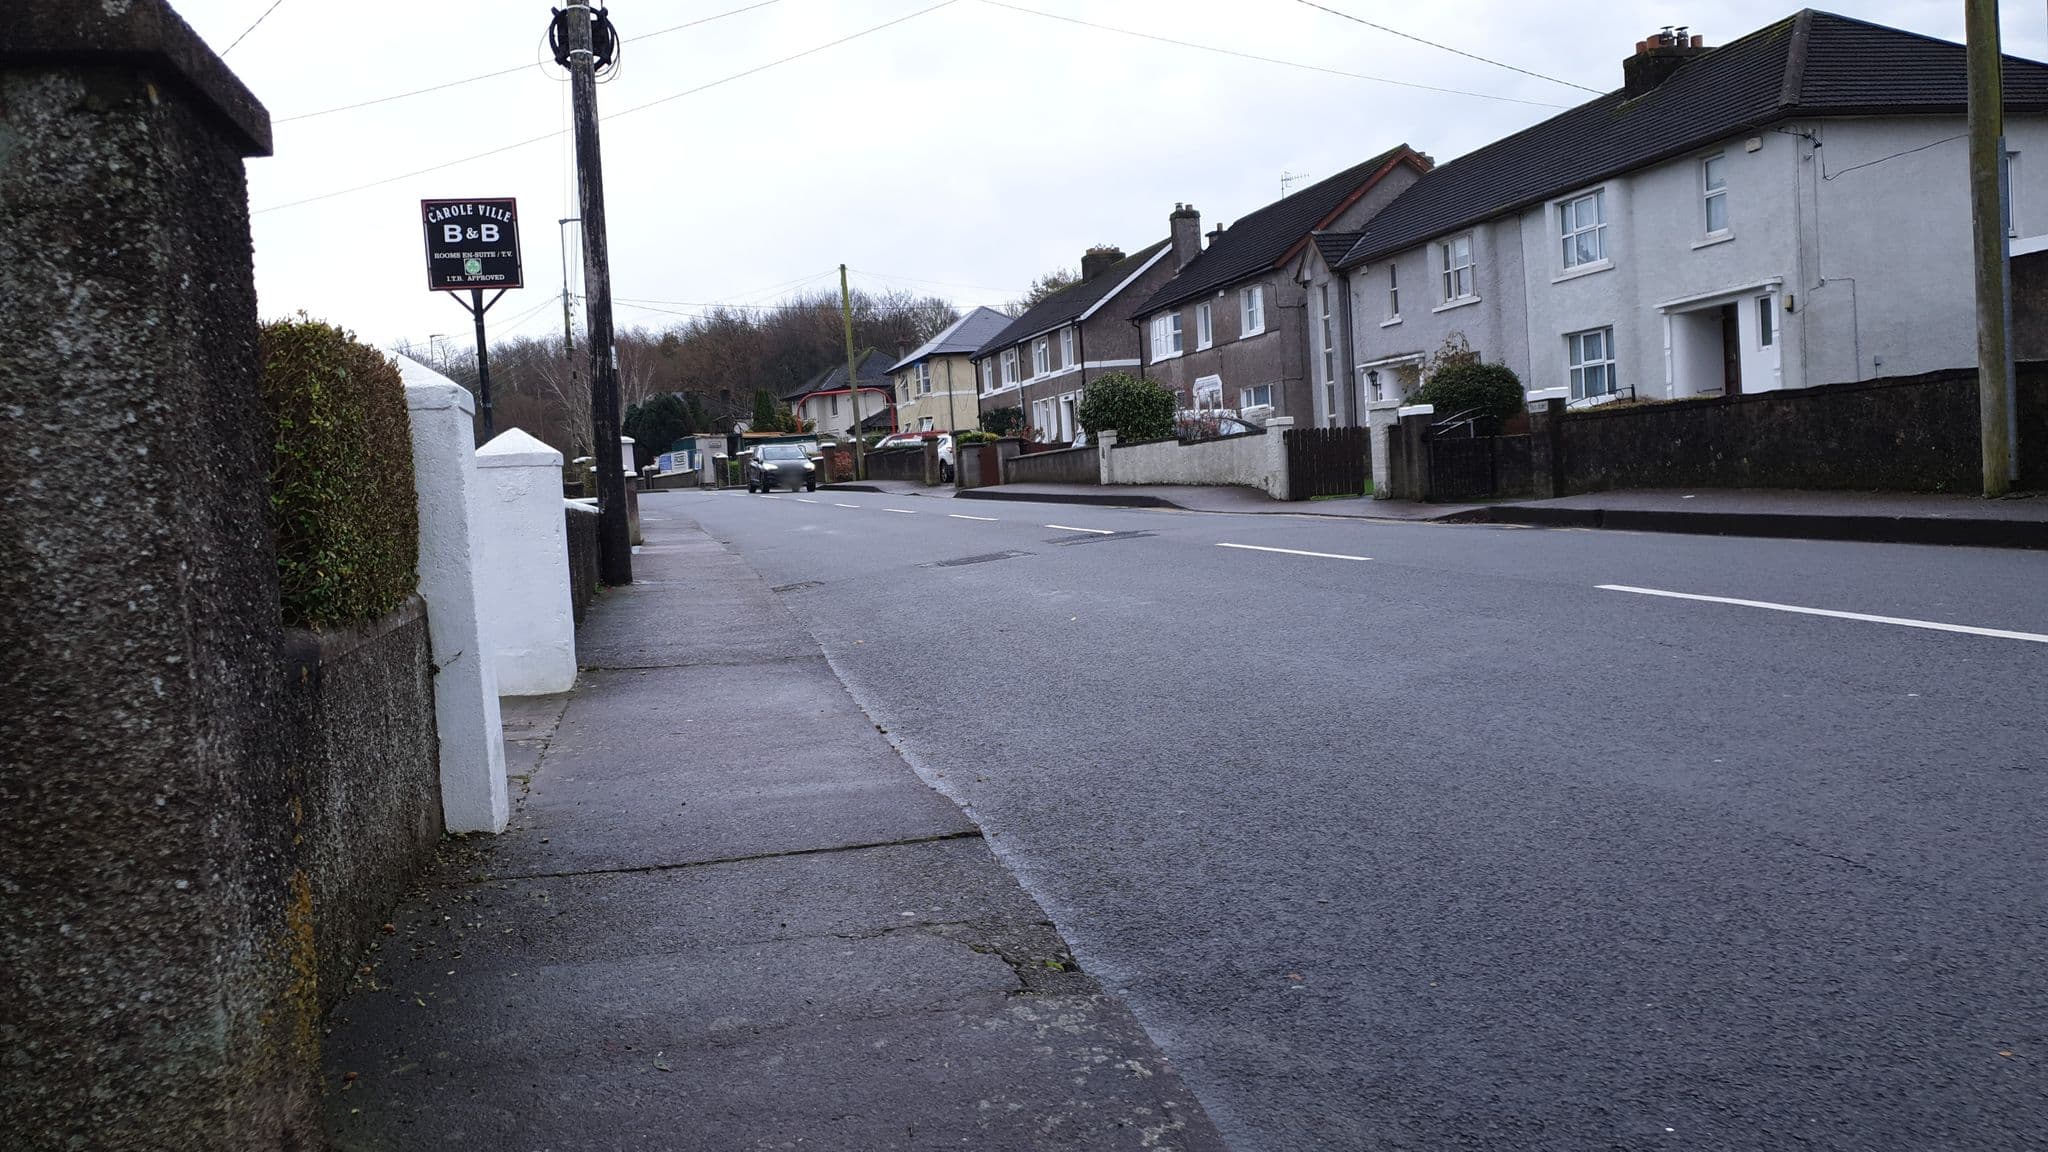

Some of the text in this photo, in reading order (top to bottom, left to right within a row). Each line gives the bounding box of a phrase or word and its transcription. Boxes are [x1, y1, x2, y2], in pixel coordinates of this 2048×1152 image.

[428, 204, 512, 223] CAROLE VILLE
[462, 251, 496, 259] EN-SUITE
[467, 274, 505, 282] APPROVED
